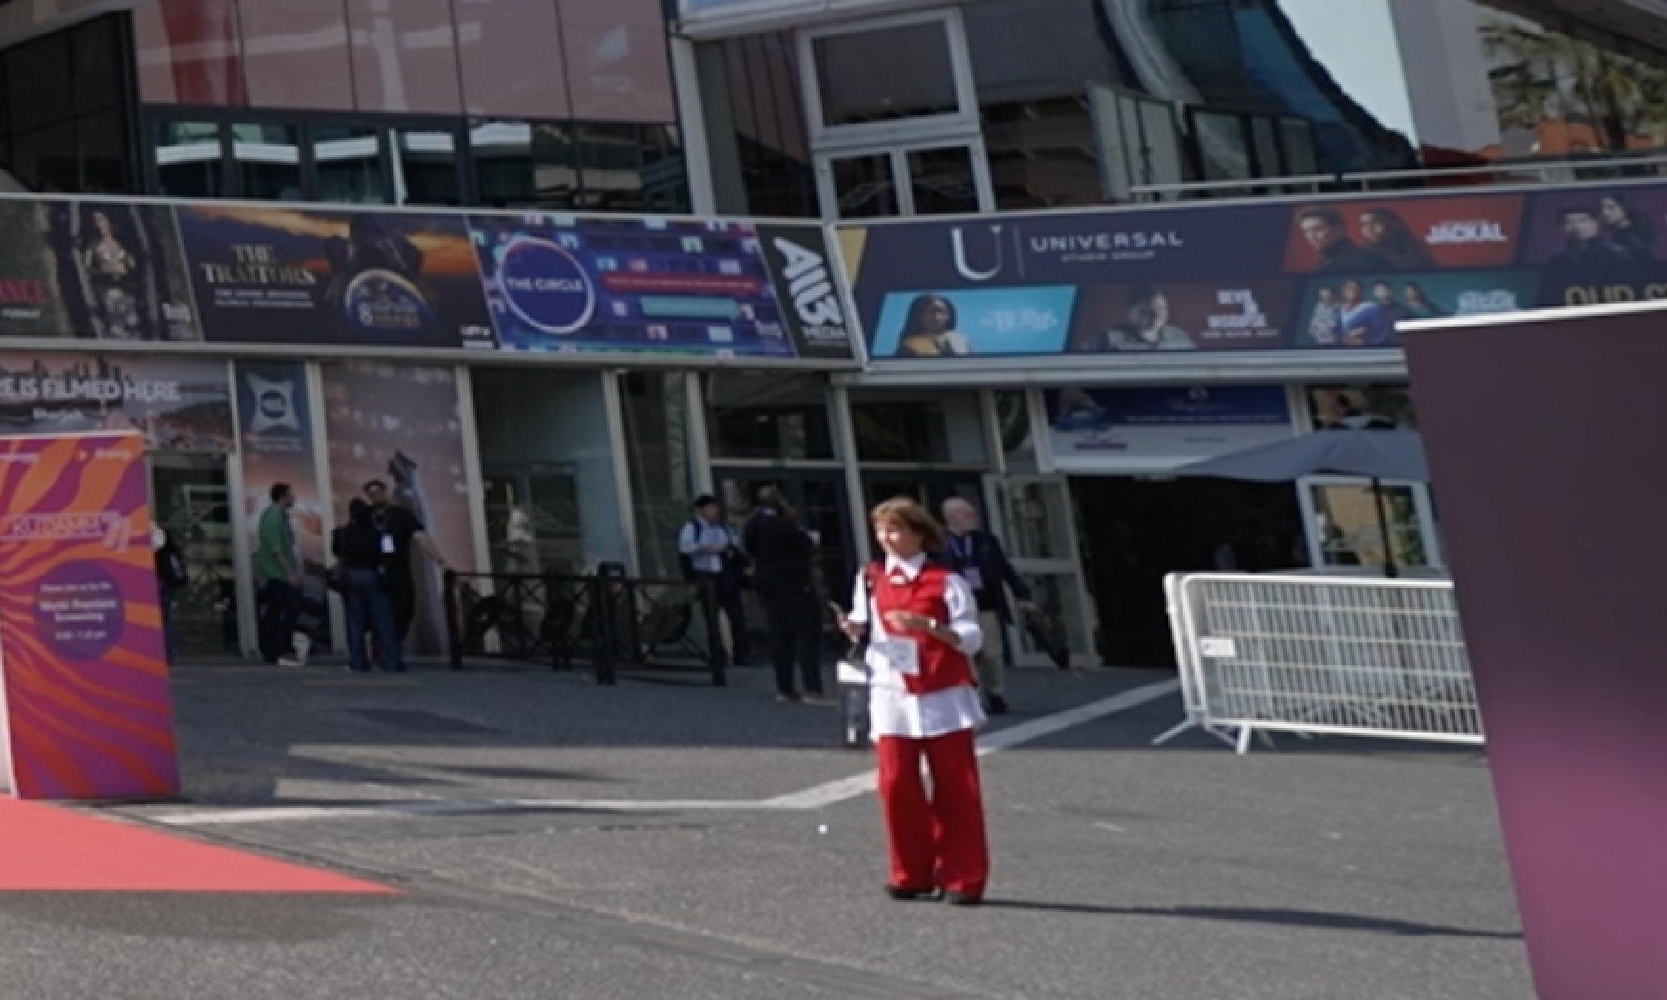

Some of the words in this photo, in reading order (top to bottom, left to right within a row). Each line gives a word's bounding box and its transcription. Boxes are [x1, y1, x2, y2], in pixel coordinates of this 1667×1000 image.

[1029, 231, 1184, 254] UNIVERSAL
[199, 261, 318, 286] TRAITORS
[42, 377, 122, 401] FILMED
[124, 379, 181, 402] HERE
